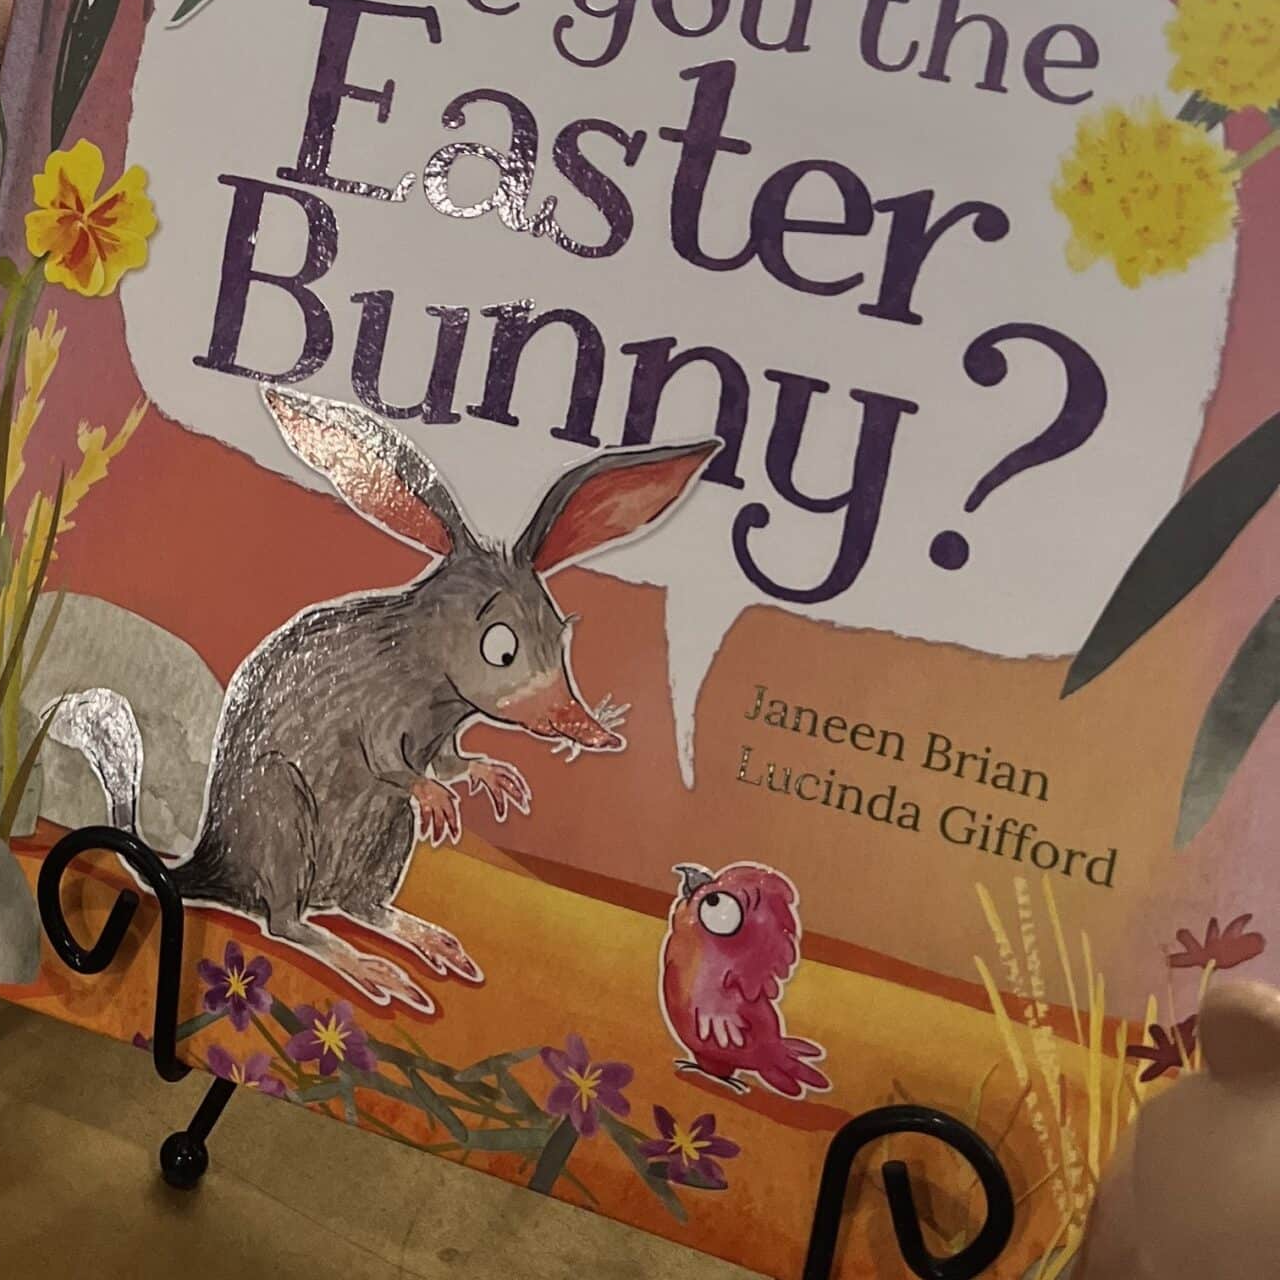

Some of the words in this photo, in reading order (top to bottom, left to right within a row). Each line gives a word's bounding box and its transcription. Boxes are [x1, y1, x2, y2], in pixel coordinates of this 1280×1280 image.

[193, 174, 1108, 604] Bunny?
[743, 684, 906, 762] Janeen
[921, 731, 1051, 802] Brian
[735, 745, 921, 832] Lucinda
[939, 805, 1119, 889] Gifford
